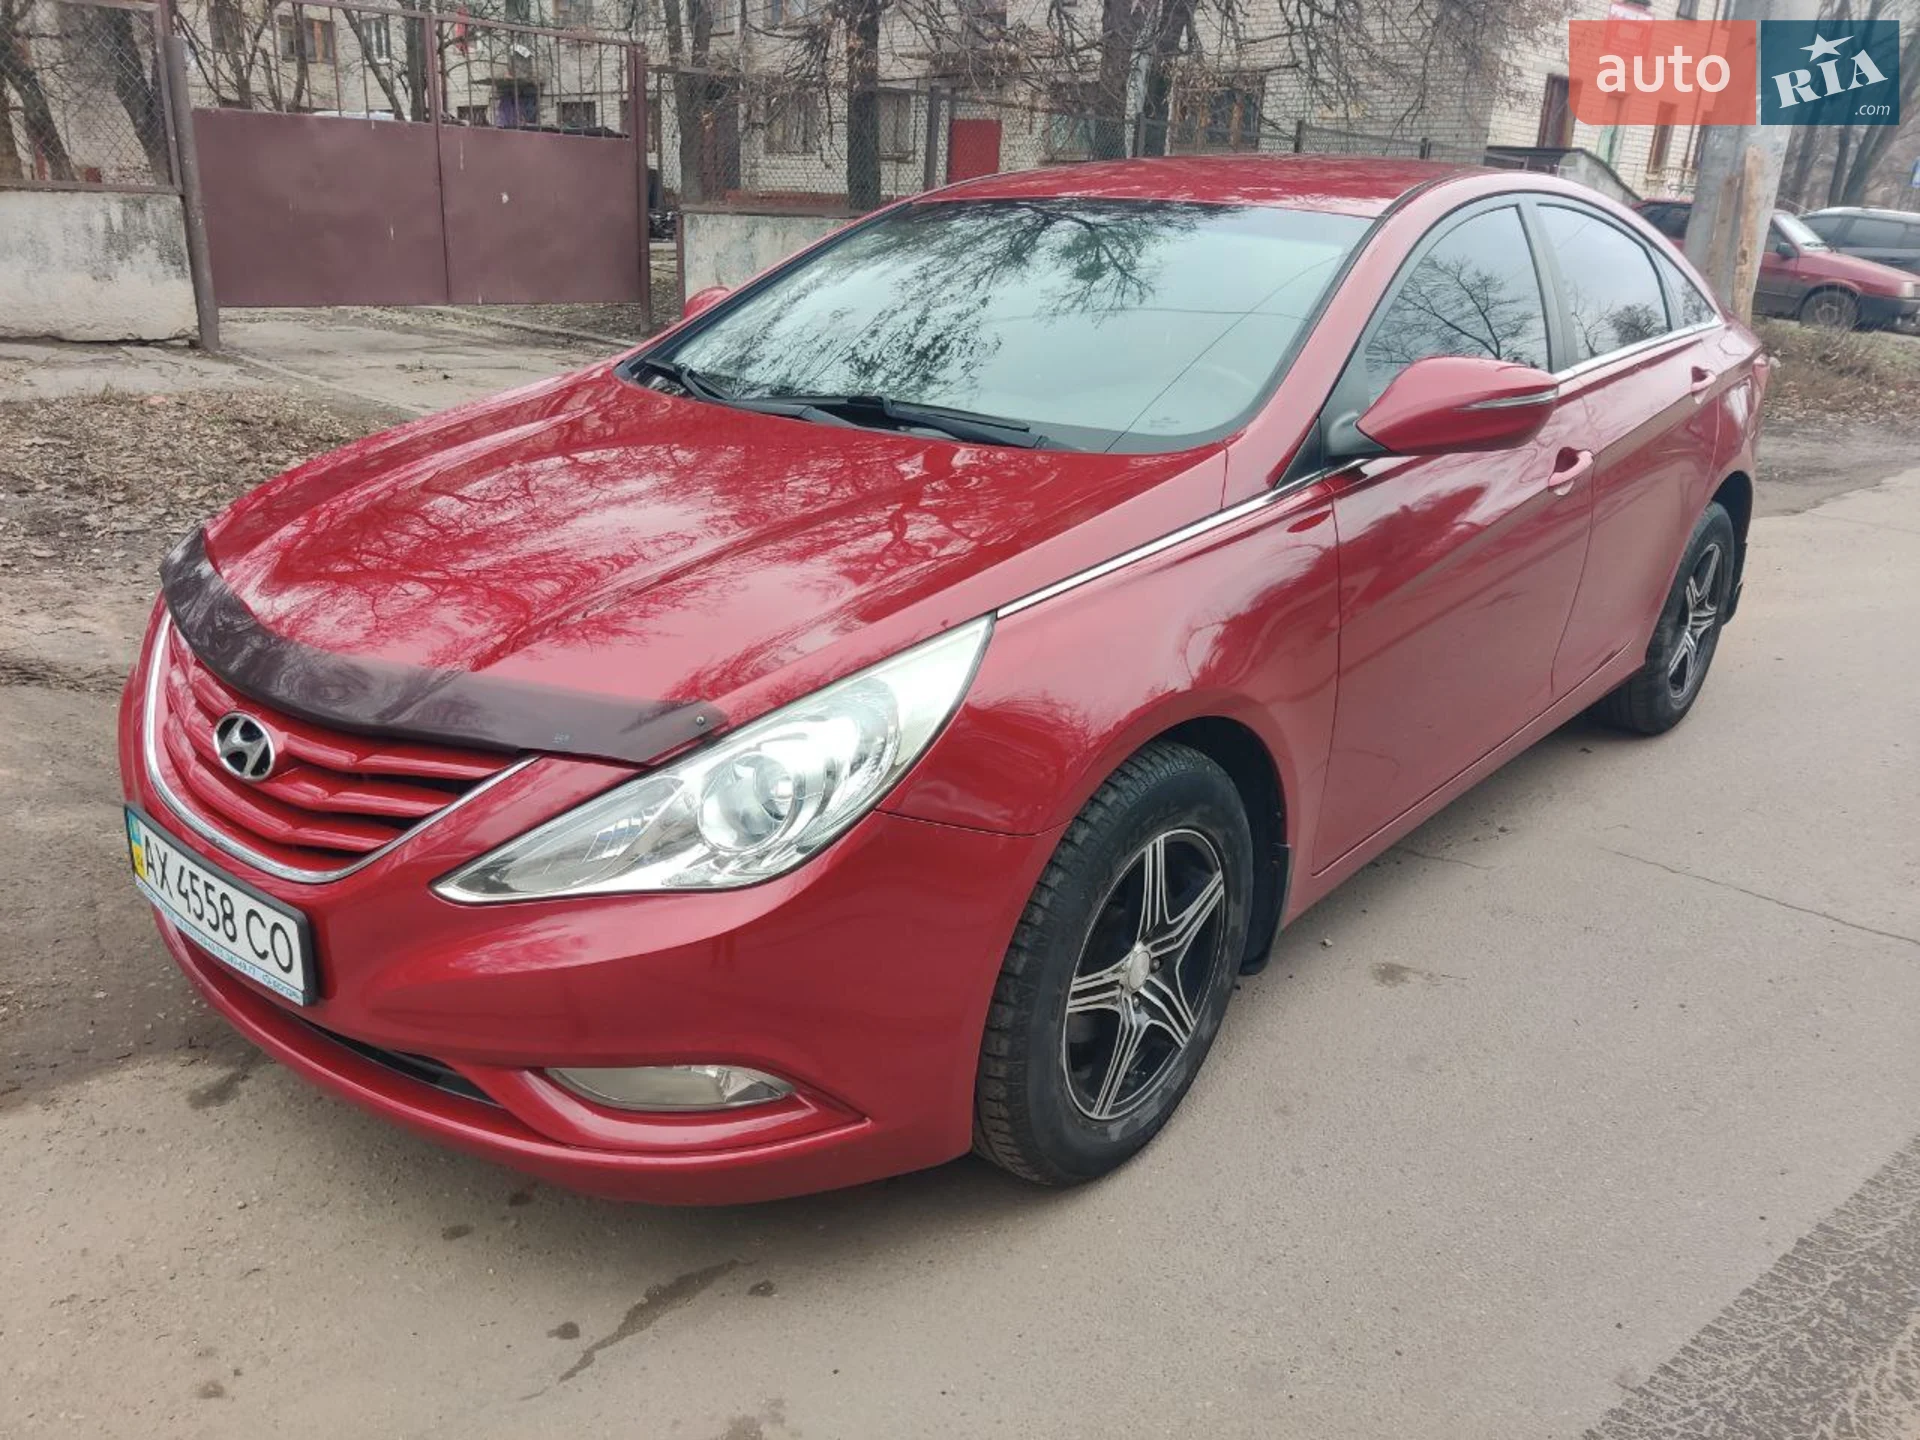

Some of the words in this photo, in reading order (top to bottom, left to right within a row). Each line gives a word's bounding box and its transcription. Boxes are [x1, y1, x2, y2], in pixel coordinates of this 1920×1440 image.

[144, 835, 174, 900] AX
[177, 865, 237, 943] 4558
[245, 908, 294, 975] CO
